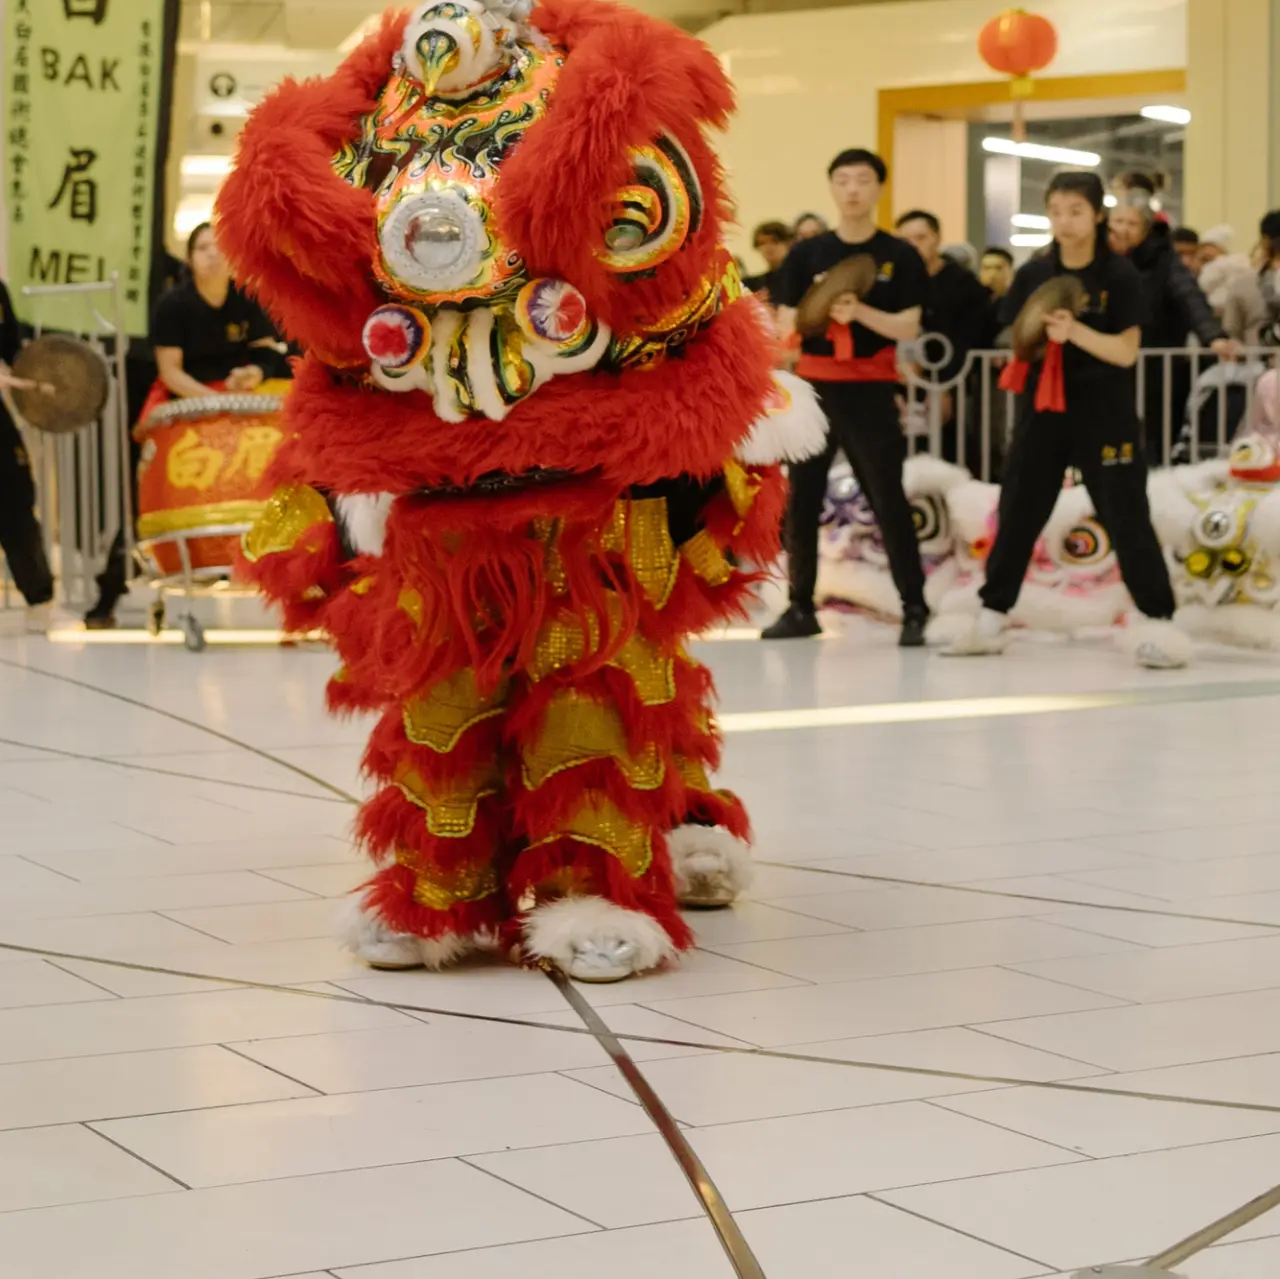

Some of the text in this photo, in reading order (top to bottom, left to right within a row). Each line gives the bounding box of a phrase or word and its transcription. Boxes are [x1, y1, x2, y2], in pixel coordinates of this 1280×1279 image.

[41, 46, 121, 94] BAK
[47, 146, 97, 225] 眉
[29, 246, 104, 284] MEI
